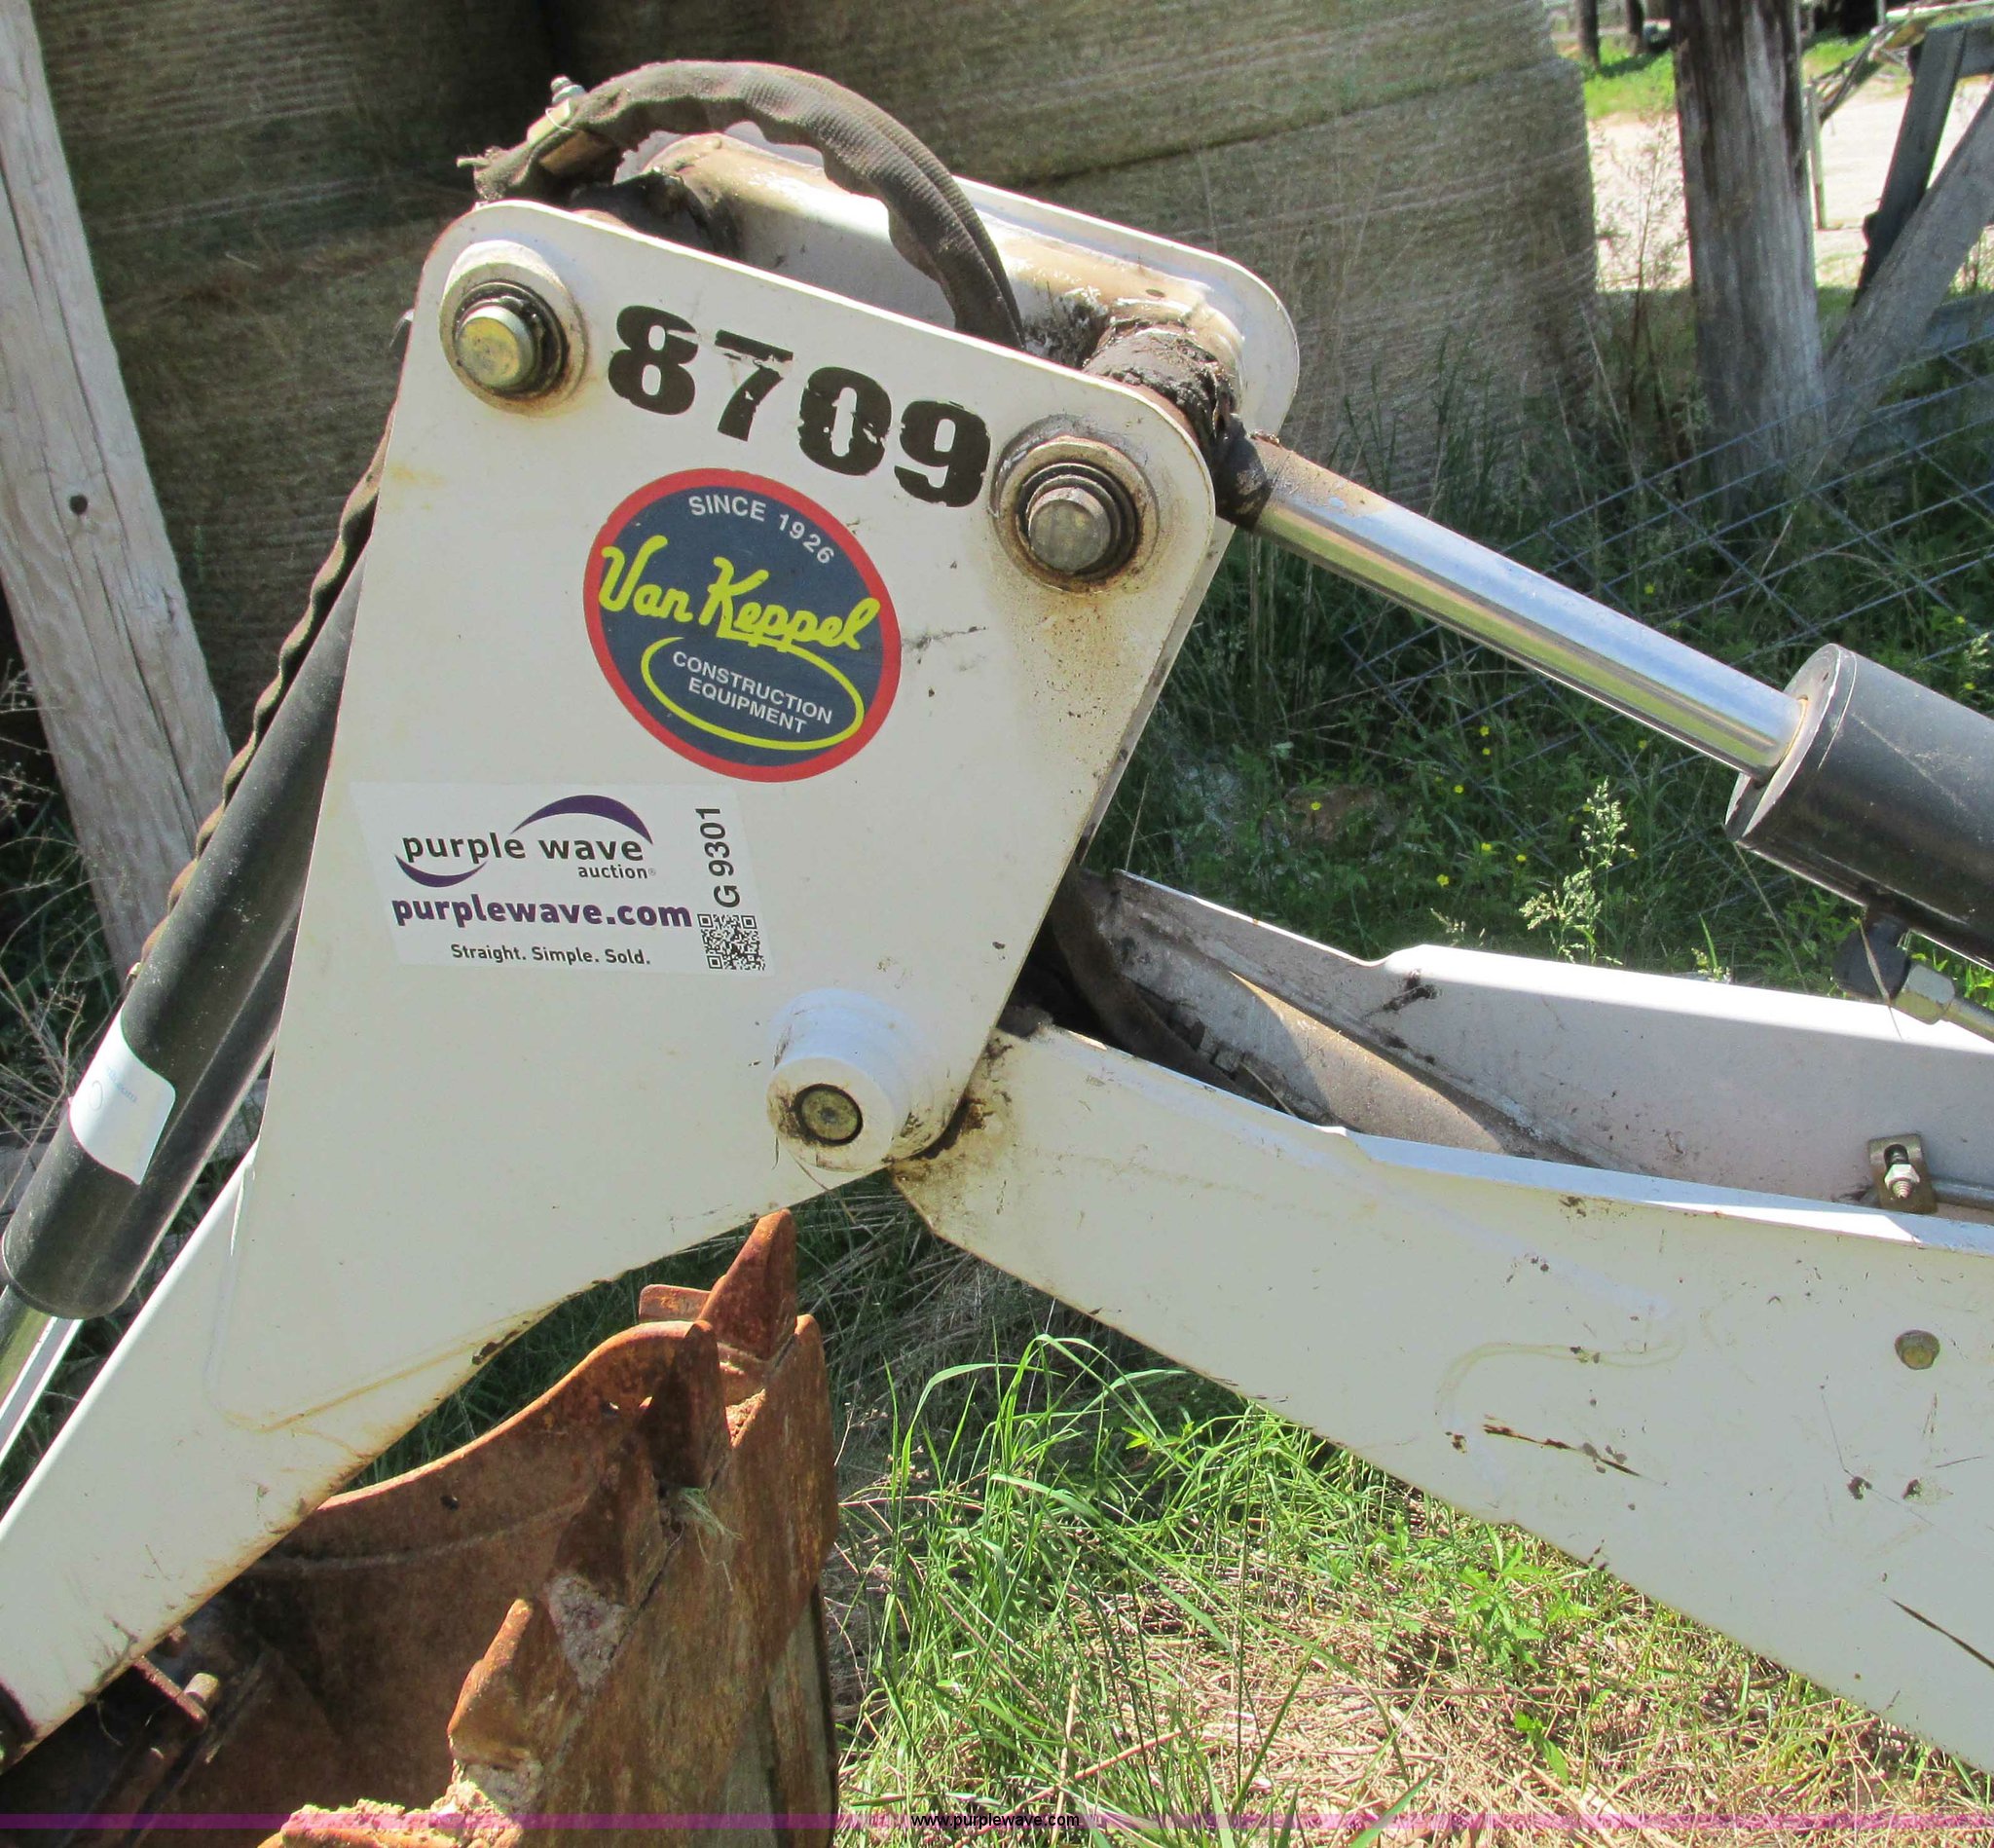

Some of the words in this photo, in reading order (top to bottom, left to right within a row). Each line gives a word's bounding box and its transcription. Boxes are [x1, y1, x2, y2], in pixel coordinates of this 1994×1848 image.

[608, 305, 991, 508] 8709
[688, 495, 766, 522] SINCE
[778, 513, 834, 564] 1926
[598, 535, 692, 623] Van
[698, 556, 880, 652] Keppel
[672, 650, 833, 724] CONSTRUCTION
[687, 676, 807, 734] EQUIPMENT
[402, 832, 527, 865] purple
[538, 837, 644, 862] wave
[695, 807, 735, 877] 9301
[391, 894, 692, 928] purplewave.com
[713, 884, 741, 907] G
[451, 943, 527, 963] Straight.
[532, 946, 600, 966] Simple.
[605, 948, 650, 965] Sold.
